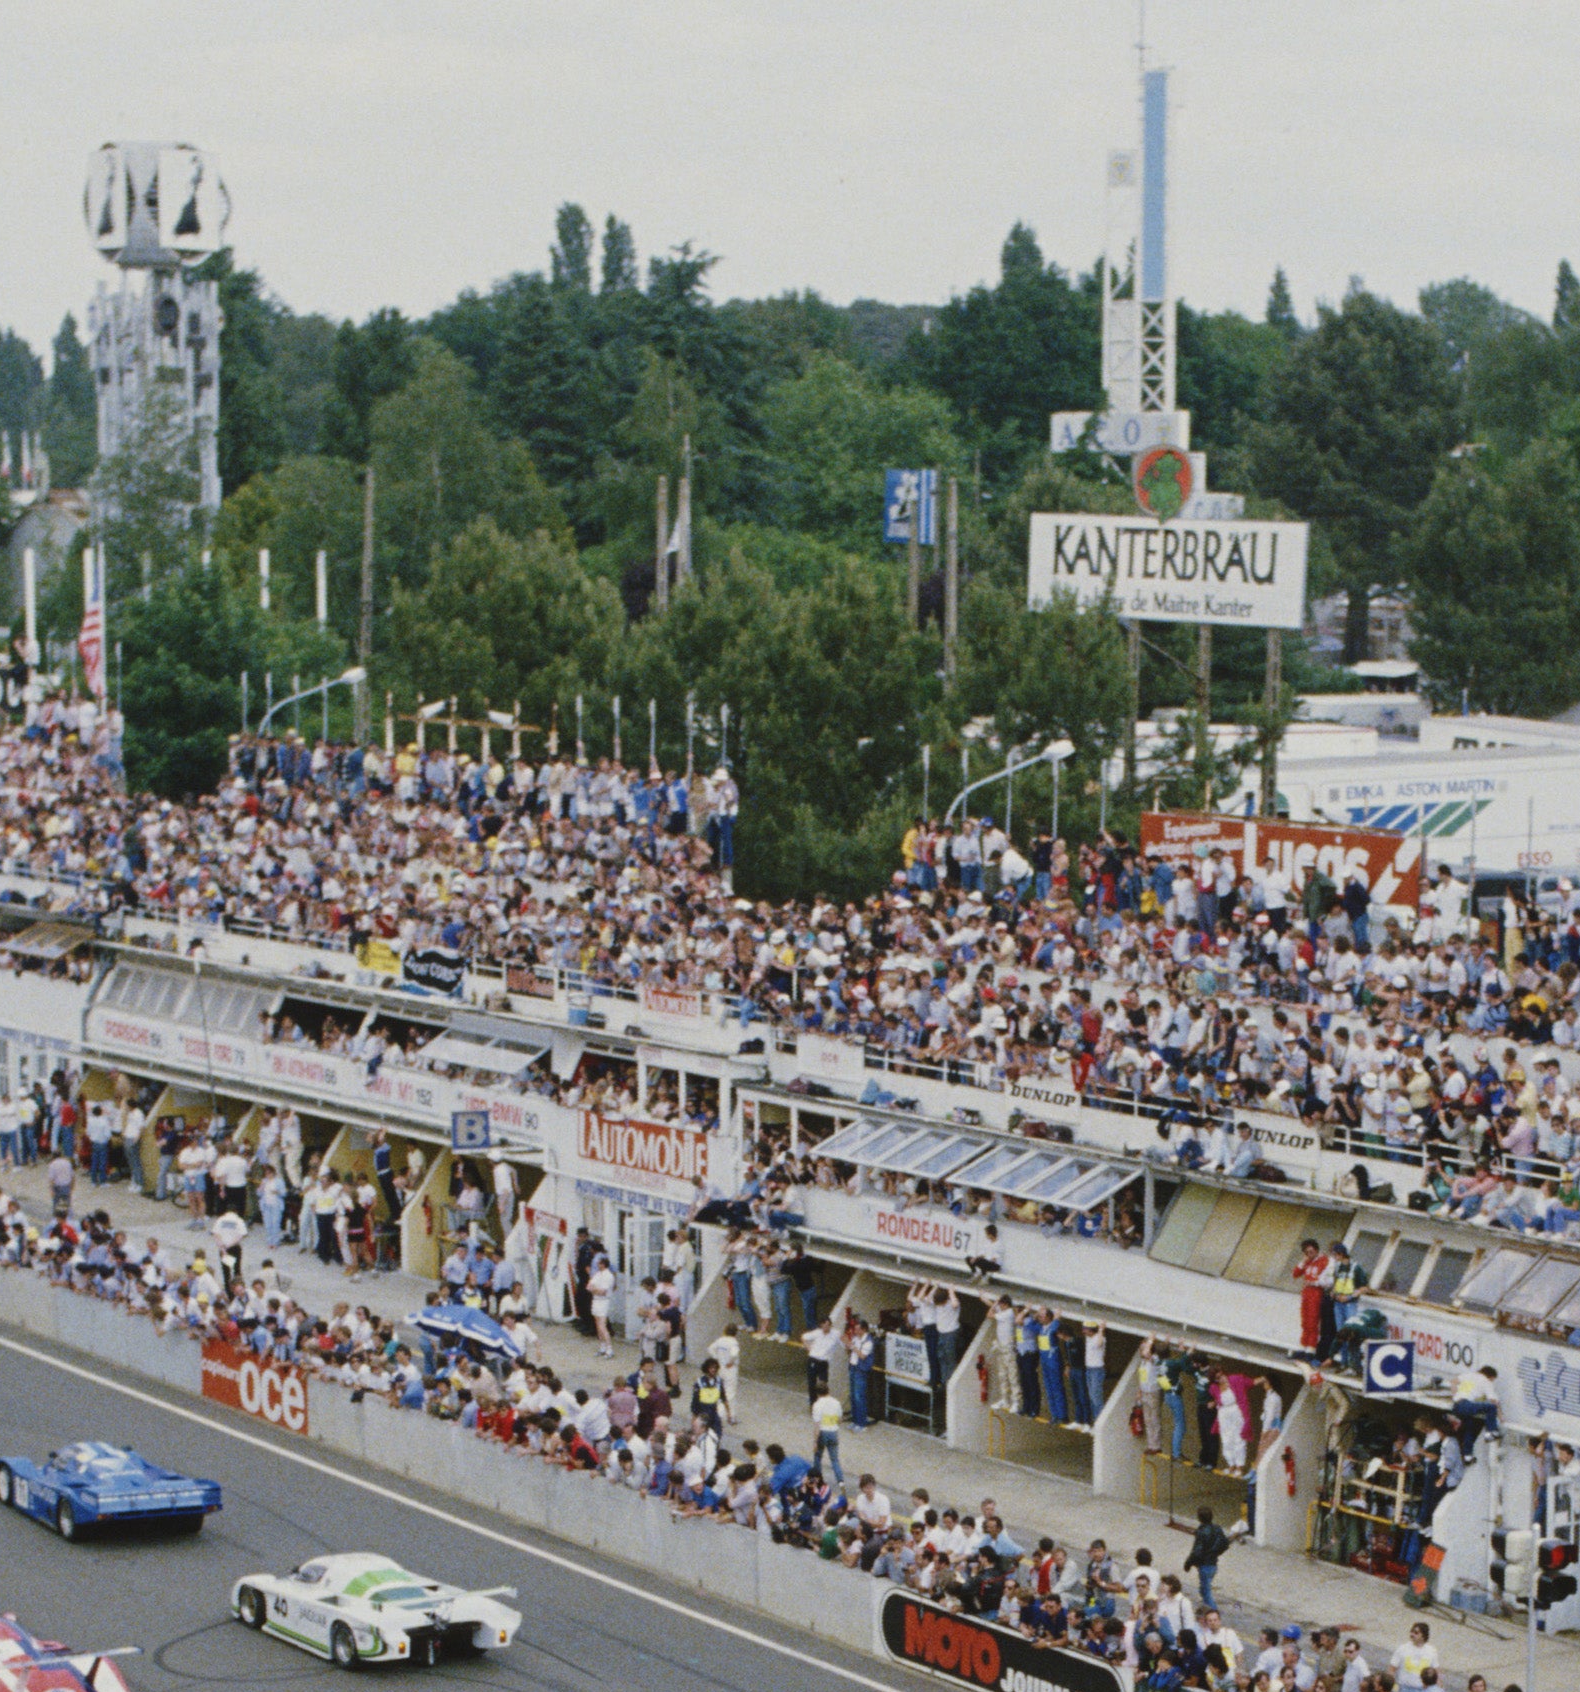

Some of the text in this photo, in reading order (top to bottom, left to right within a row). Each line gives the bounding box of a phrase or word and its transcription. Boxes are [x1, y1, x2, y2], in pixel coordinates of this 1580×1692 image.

[1053, 524, 1279, 586] KANTERBRÄU
[1395, 781, 1442, 797] ASTON
[1446, 779, 1497, 795] MARTIN
[1010, 1084, 1077, 1107] DUNLOP
[456, 1113, 488, 1146] B
[876, 1211, 972, 1253] RONDEAU 67
[1369, 1344, 1407, 1389] C
[1444, 1340, 1474, 1369] 100
[903, 1605, 1002, 1685] MOTO
